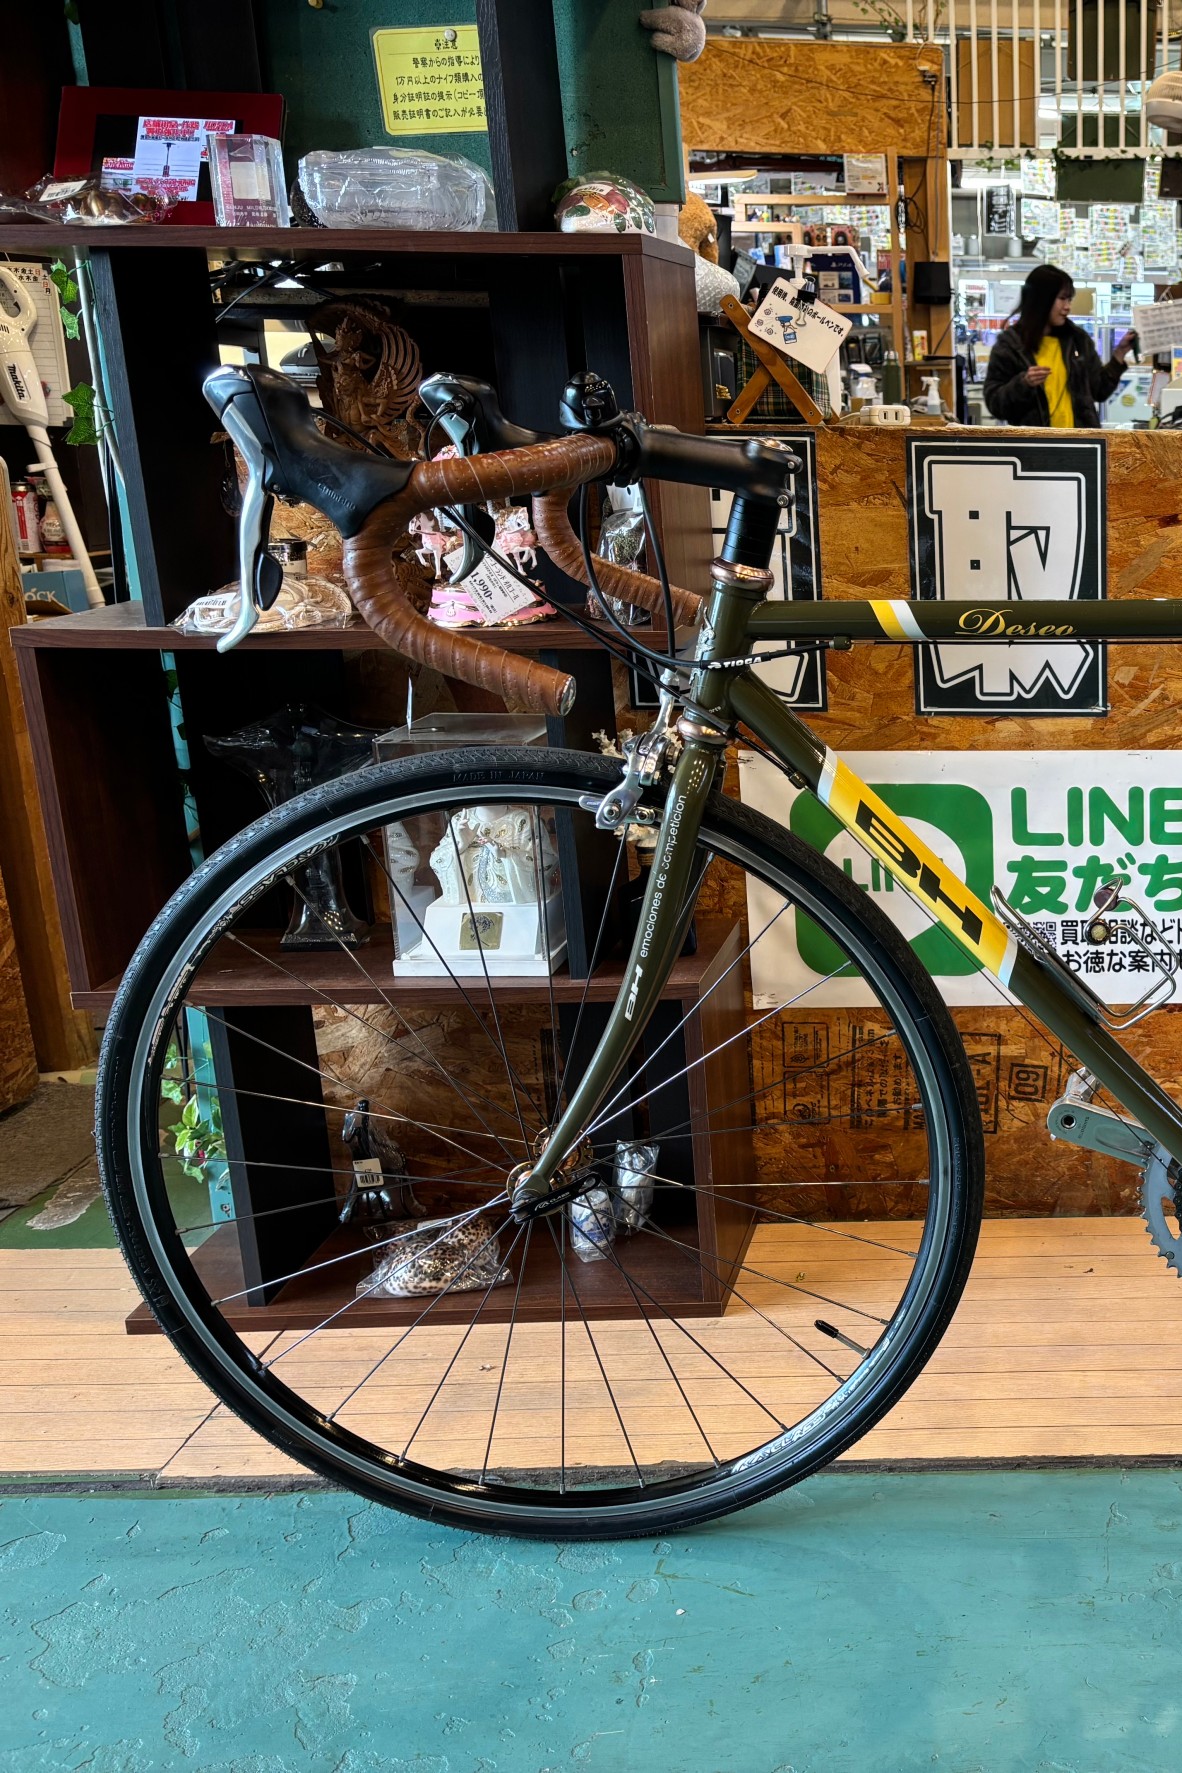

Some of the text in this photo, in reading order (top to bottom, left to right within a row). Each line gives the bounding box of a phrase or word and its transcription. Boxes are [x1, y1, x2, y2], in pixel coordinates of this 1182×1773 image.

[954, 608, 1078, 636] Deseo
[855, 799, 984, 946] BH
[640, 892, 663, 958] emociones
[624, 964, 643, 1021] BH
